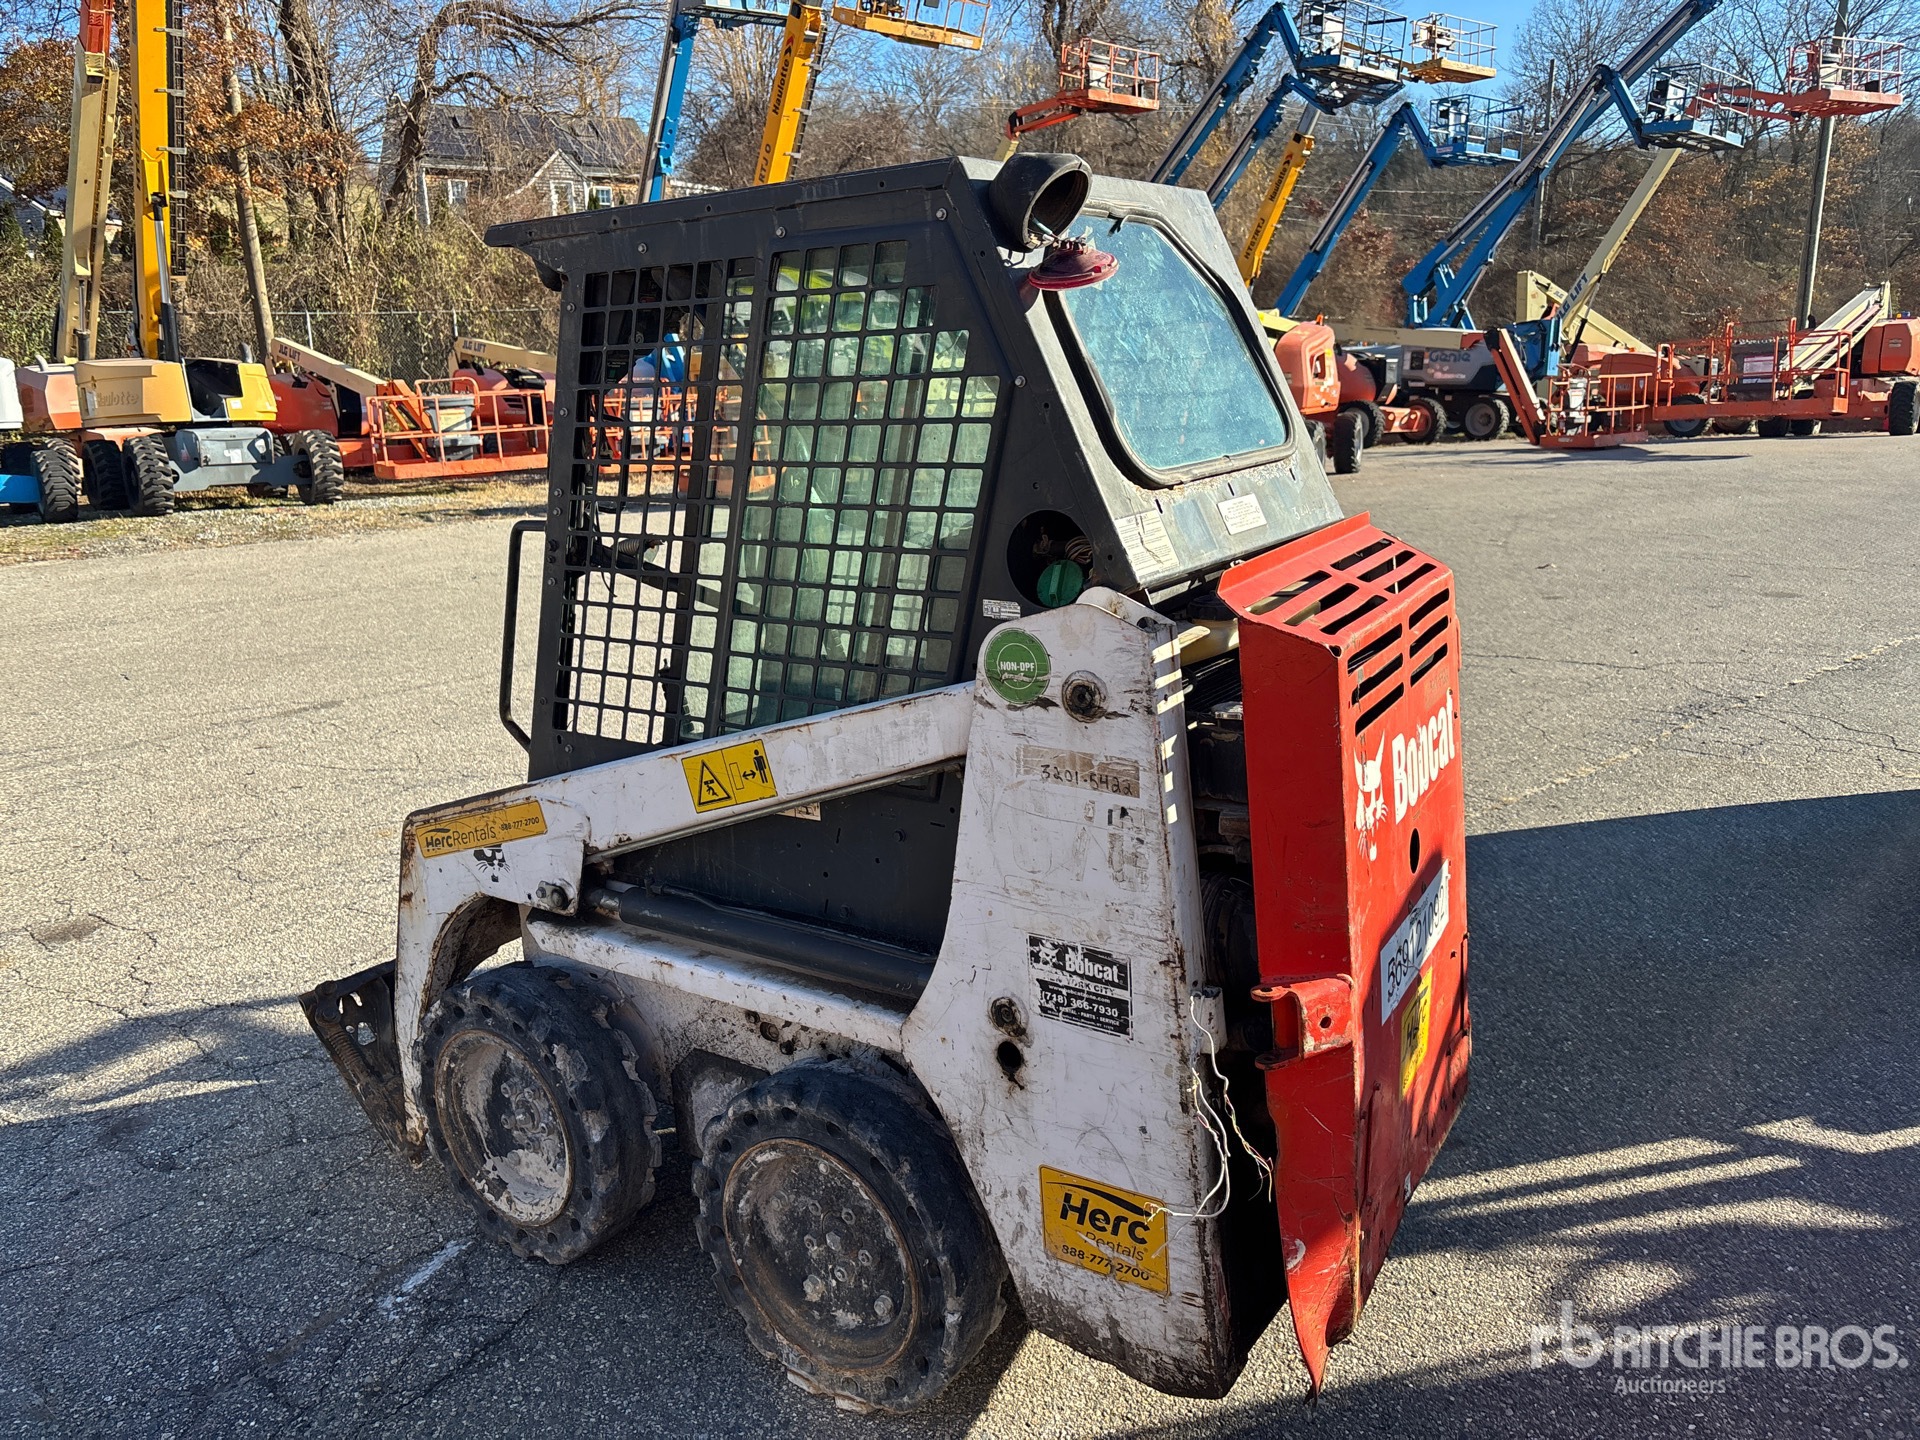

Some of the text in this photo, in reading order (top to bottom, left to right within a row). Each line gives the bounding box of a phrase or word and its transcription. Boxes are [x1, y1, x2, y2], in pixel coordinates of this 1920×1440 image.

[772, 58, 790, 116] Haulotte
[1268, 167, 1288, 202] Haulotte
[1570, 273, 1588, 301] LIFT
[279, 344, 301, 362] JLG LIFT
[474, 342, 487, 353] LIFT
[1429, 350, 1471, 362] Genie
[1000, 661, 1035, 672] NON-DPF
[1391, 687, 1456, 825] Bobcat
[1065, 953, 1119, 983] Bobcat
[1041, 991, 1119, 1017] (718) 366-7930
[1059, 1192, 1151, 1245] Herc
[1084, 1231, 1145, 1262] Rentals
